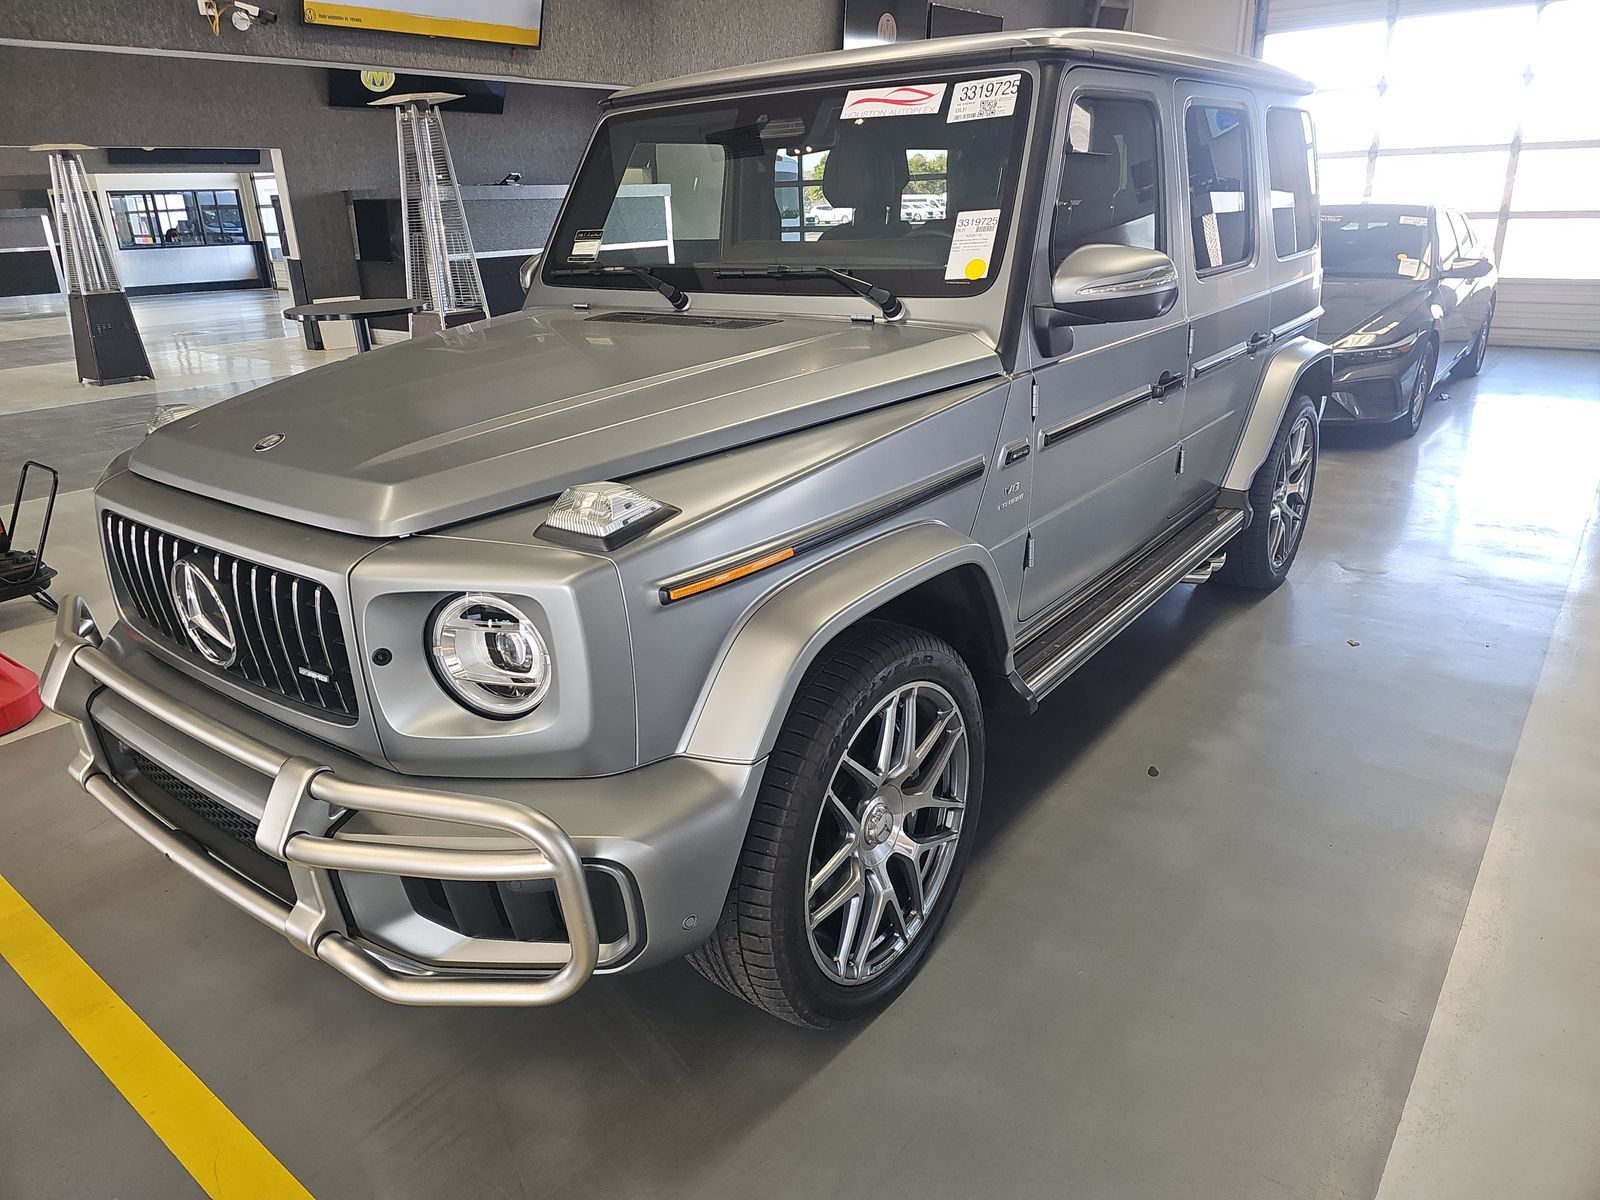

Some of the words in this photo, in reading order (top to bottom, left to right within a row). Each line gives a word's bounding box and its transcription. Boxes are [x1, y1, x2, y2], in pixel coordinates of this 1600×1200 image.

[959, 80, 1019, 101] 3319725
[844, 110, 887, 118] HOUSTON
[889, 106, 936, 116] AUTOPLEX
[957, 217, 998, 227] 3319725
